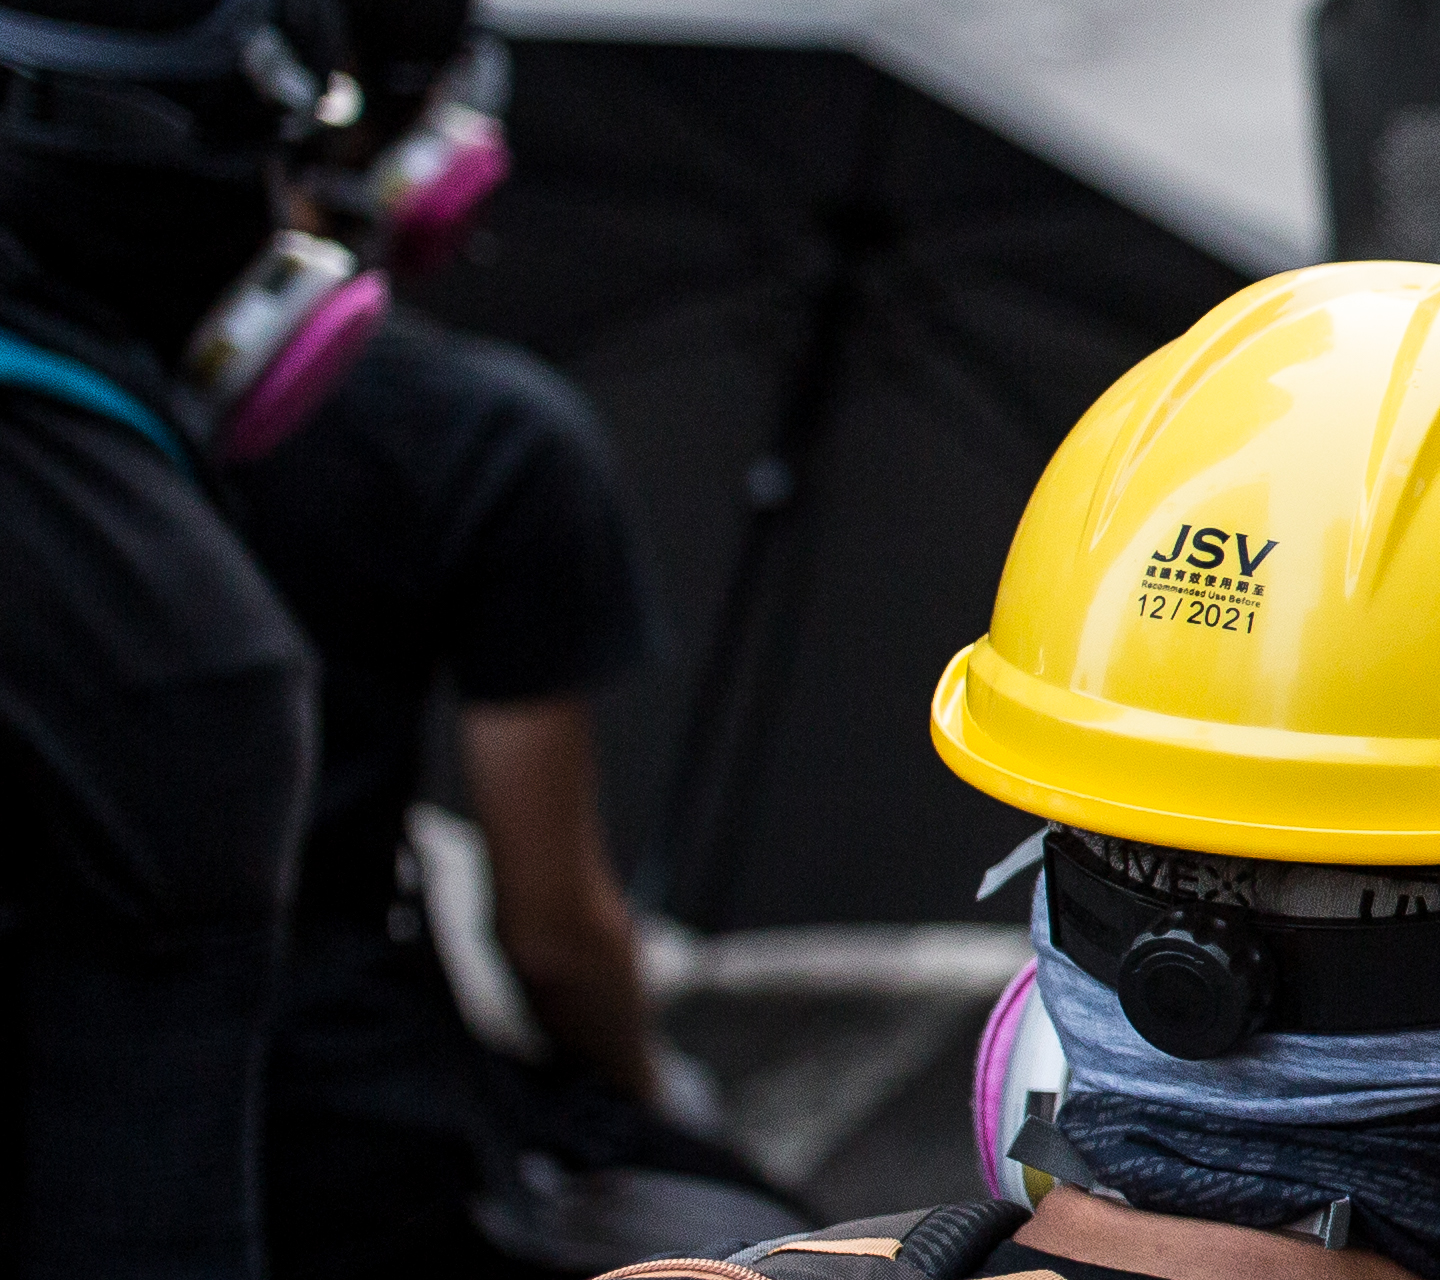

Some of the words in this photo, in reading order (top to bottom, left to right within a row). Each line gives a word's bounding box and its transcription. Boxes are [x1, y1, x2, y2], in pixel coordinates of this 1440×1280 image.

[1151, 524, 1280, 577] JSV
[1141, 579, 1206, 598] Recommended
[1208, 591, 1226, 602] Use
[1229, 594, 1261, 609] Before
